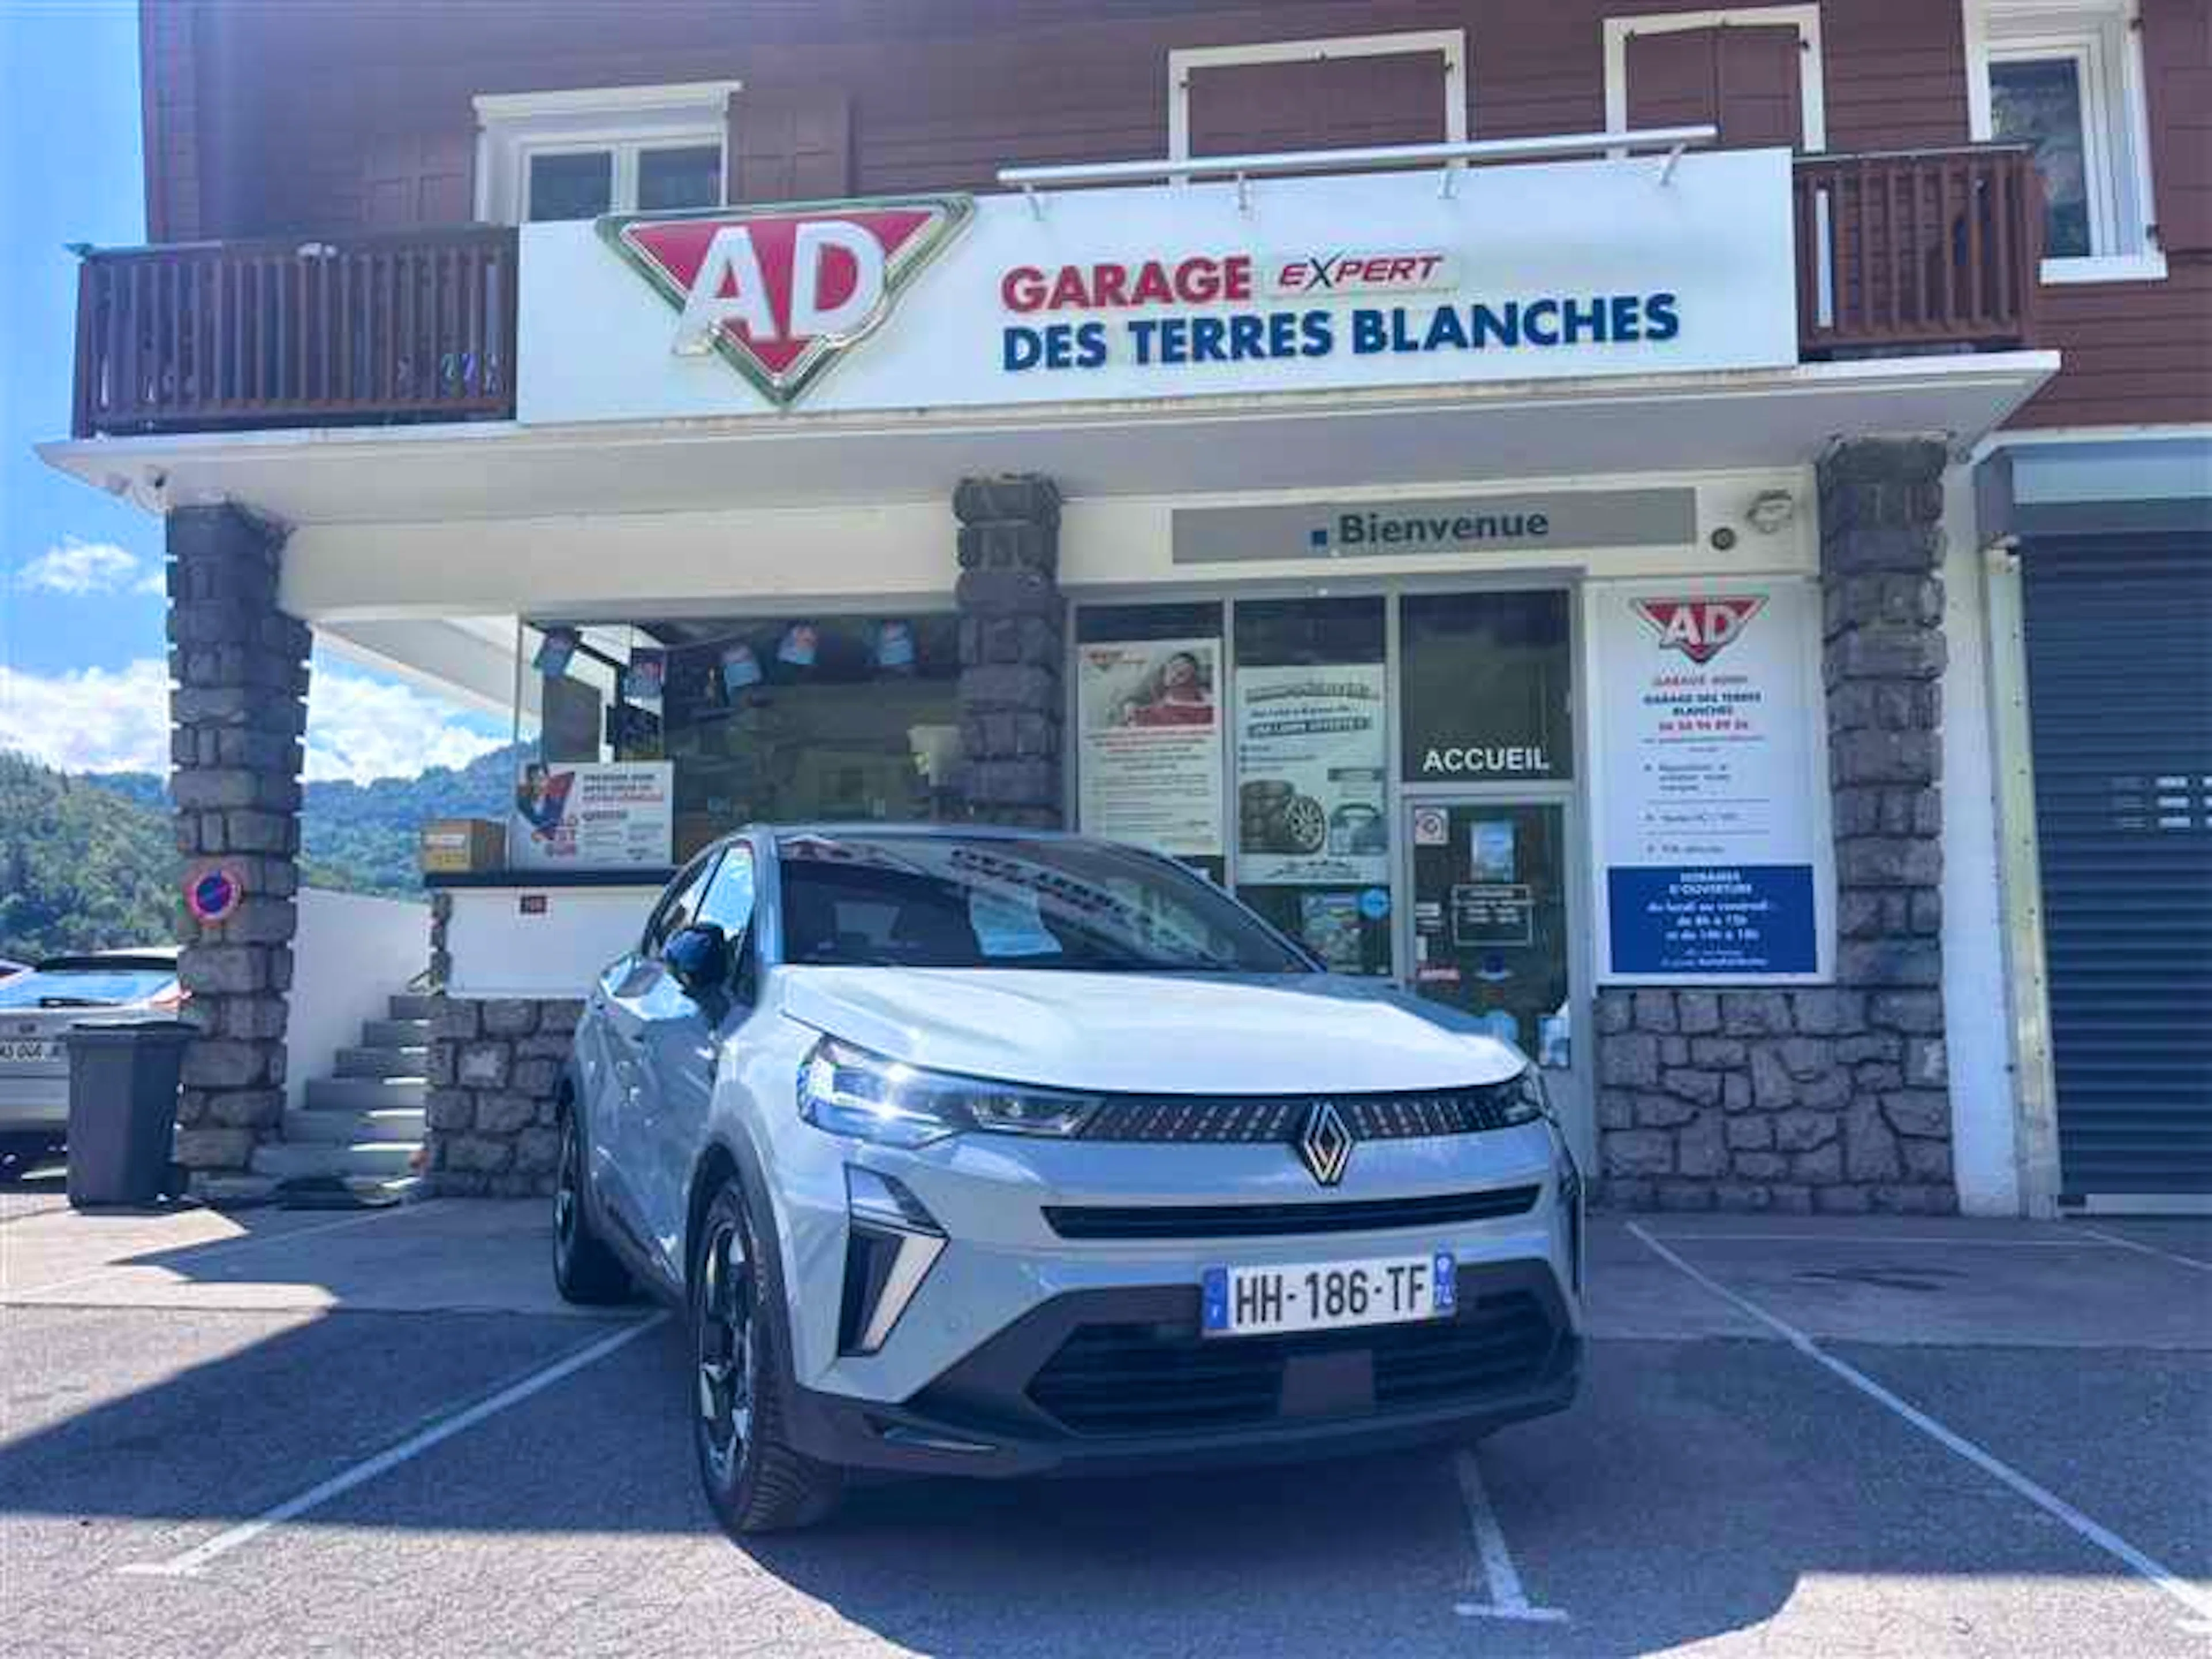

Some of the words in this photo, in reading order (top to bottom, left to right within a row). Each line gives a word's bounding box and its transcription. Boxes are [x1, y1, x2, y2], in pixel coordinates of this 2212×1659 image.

[673, 220, 888, 355] AD
[1001, 256, 1251, 313] GARAGE
[1278, 252, 1442, 289] EXPERT
[1003, 322, 1107, 370] DES
[1127, 310, 1333, 365] TERRES
[1352, 294, 1679, 354] BLANCHES
[1339, 512, 1550, 544] Bienvenue
[1659, 604, 1736, 647] AD
[1422, 747, 1550, 772] ACCUEIL
[1236, 1266, 1427, 1324] HH-186-TF
